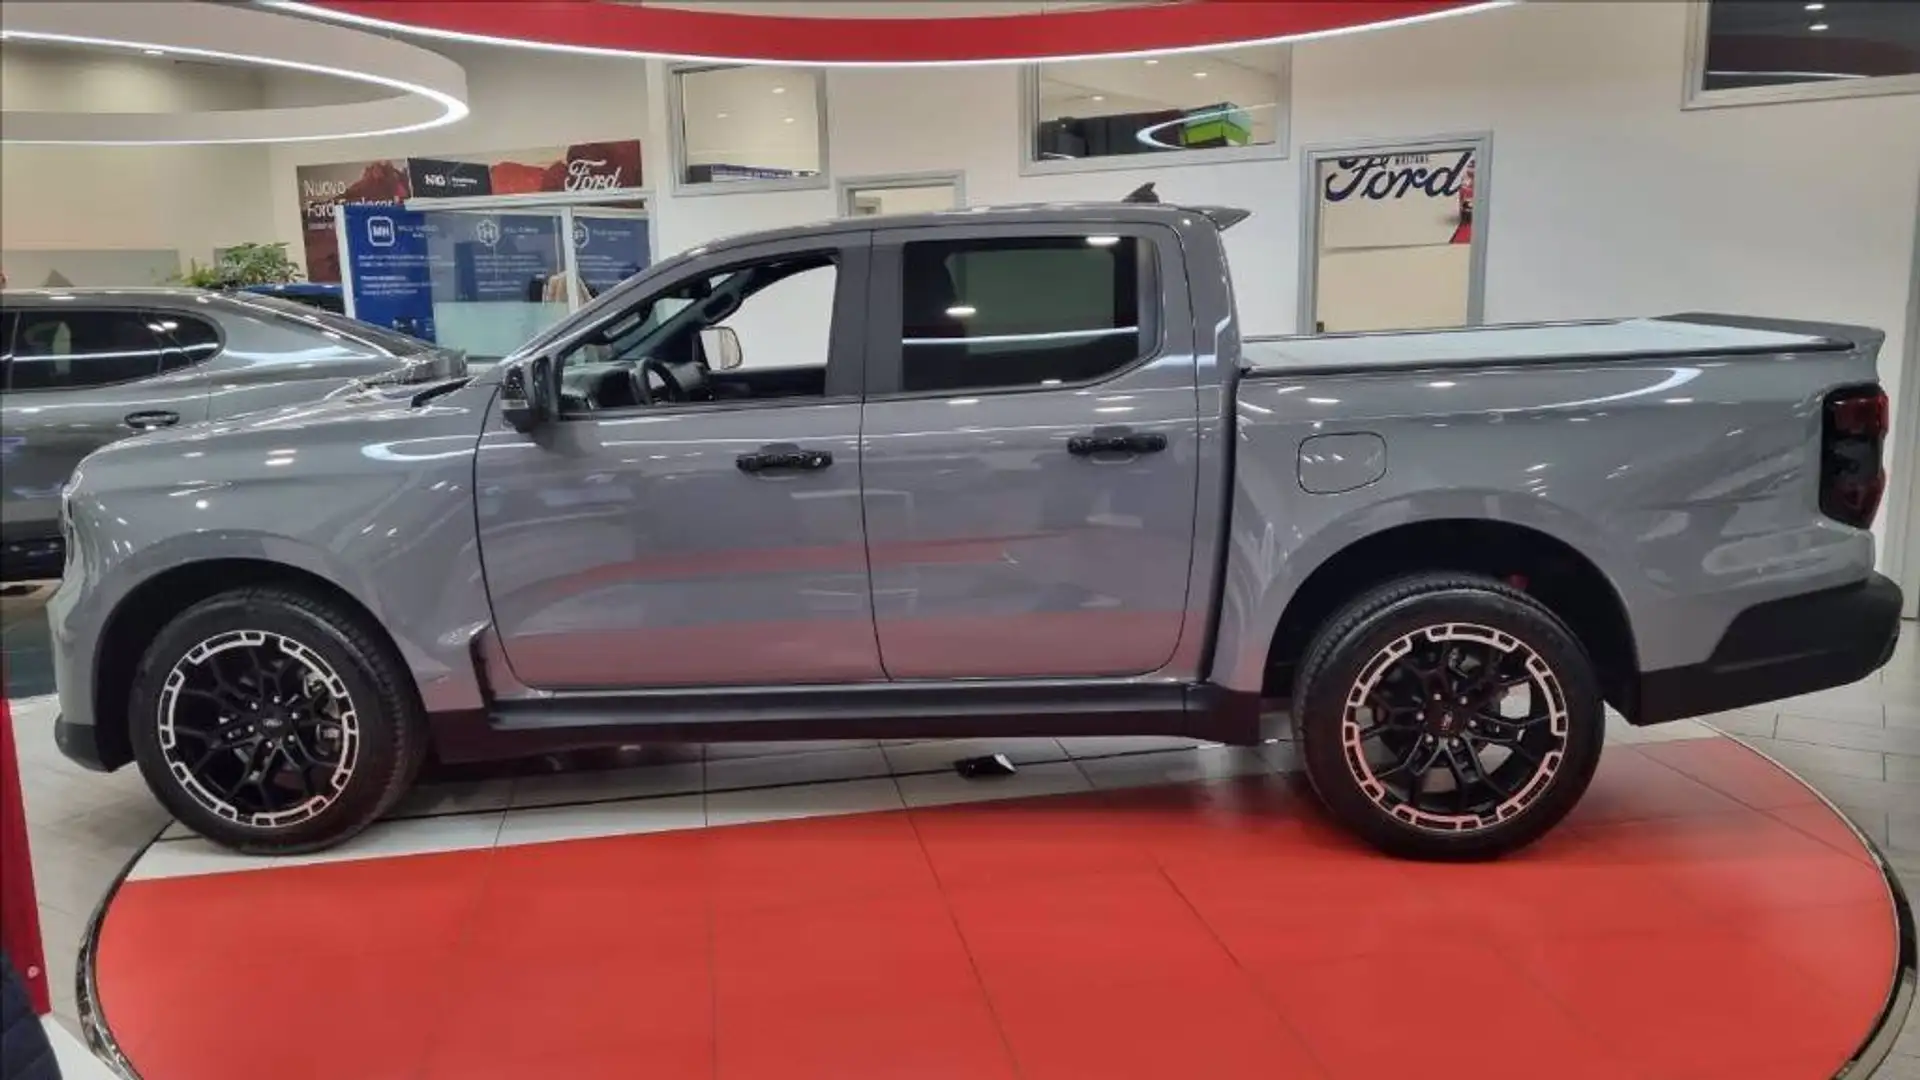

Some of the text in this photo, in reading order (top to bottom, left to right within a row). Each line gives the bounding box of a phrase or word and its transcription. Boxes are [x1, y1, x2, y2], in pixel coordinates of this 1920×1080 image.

[565, 159, 622, 192] Ford
[1325, 152, 1472, 202] Ford
[303, 180, 347, 197] Nuovo
[307, 200, 336, 217] Ford
